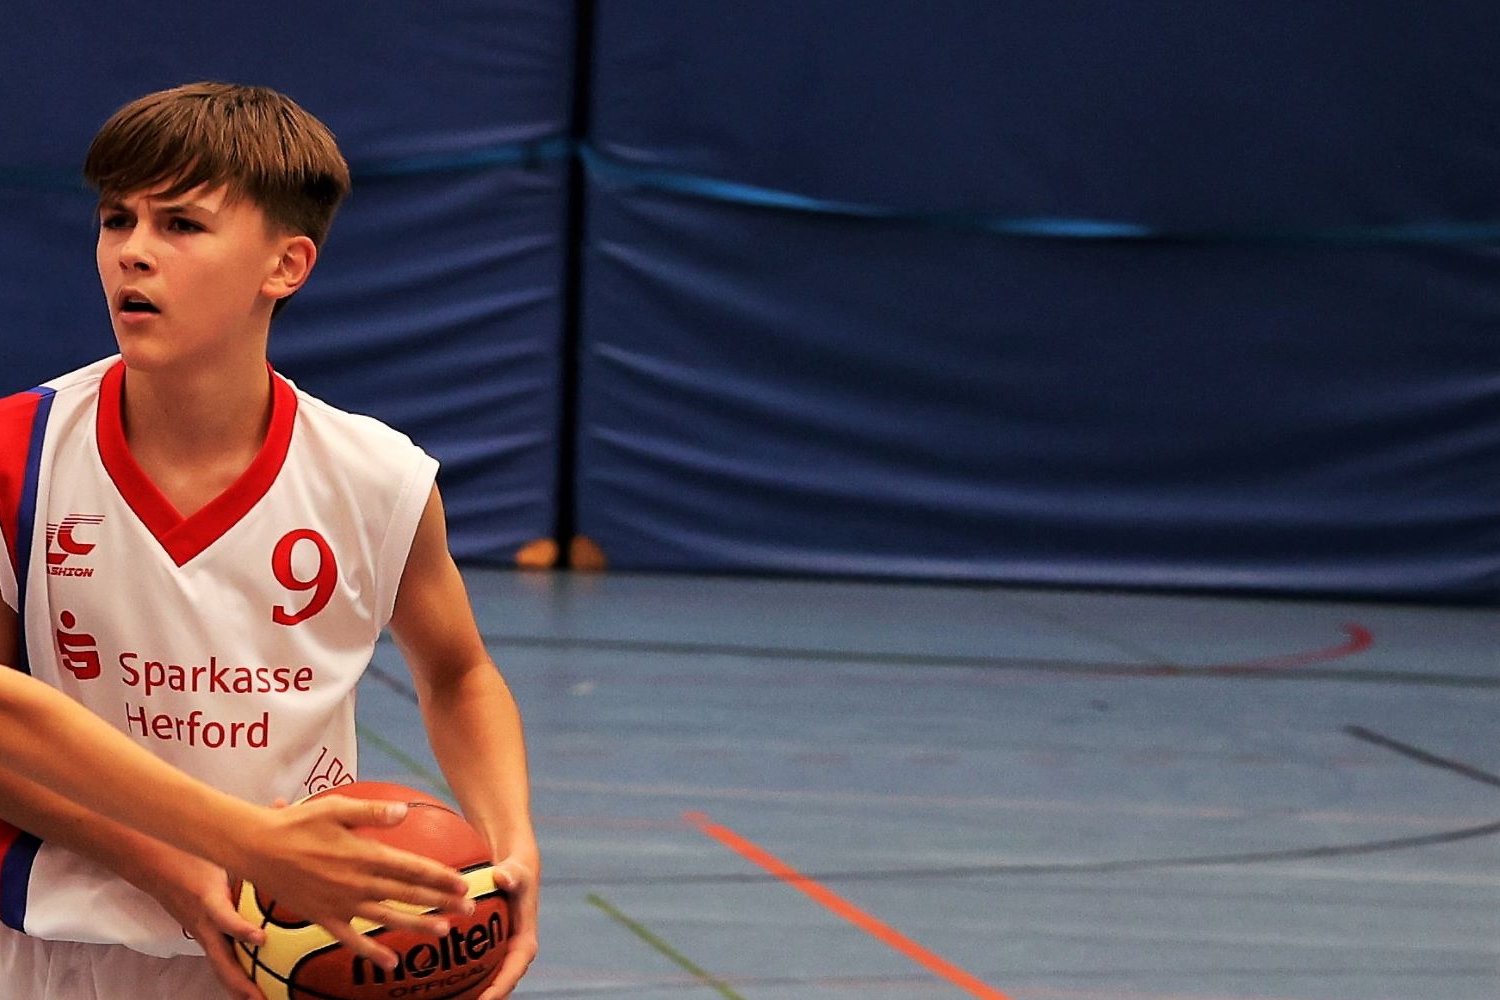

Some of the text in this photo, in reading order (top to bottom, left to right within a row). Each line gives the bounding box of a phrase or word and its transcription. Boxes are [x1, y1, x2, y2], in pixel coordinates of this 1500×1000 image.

[271, 528, 338, 626] 9
[118, 652, 313, 696] Sparkasse
[125, 702, 270, 748] Herford
[352, 911, 503, 986] molten
